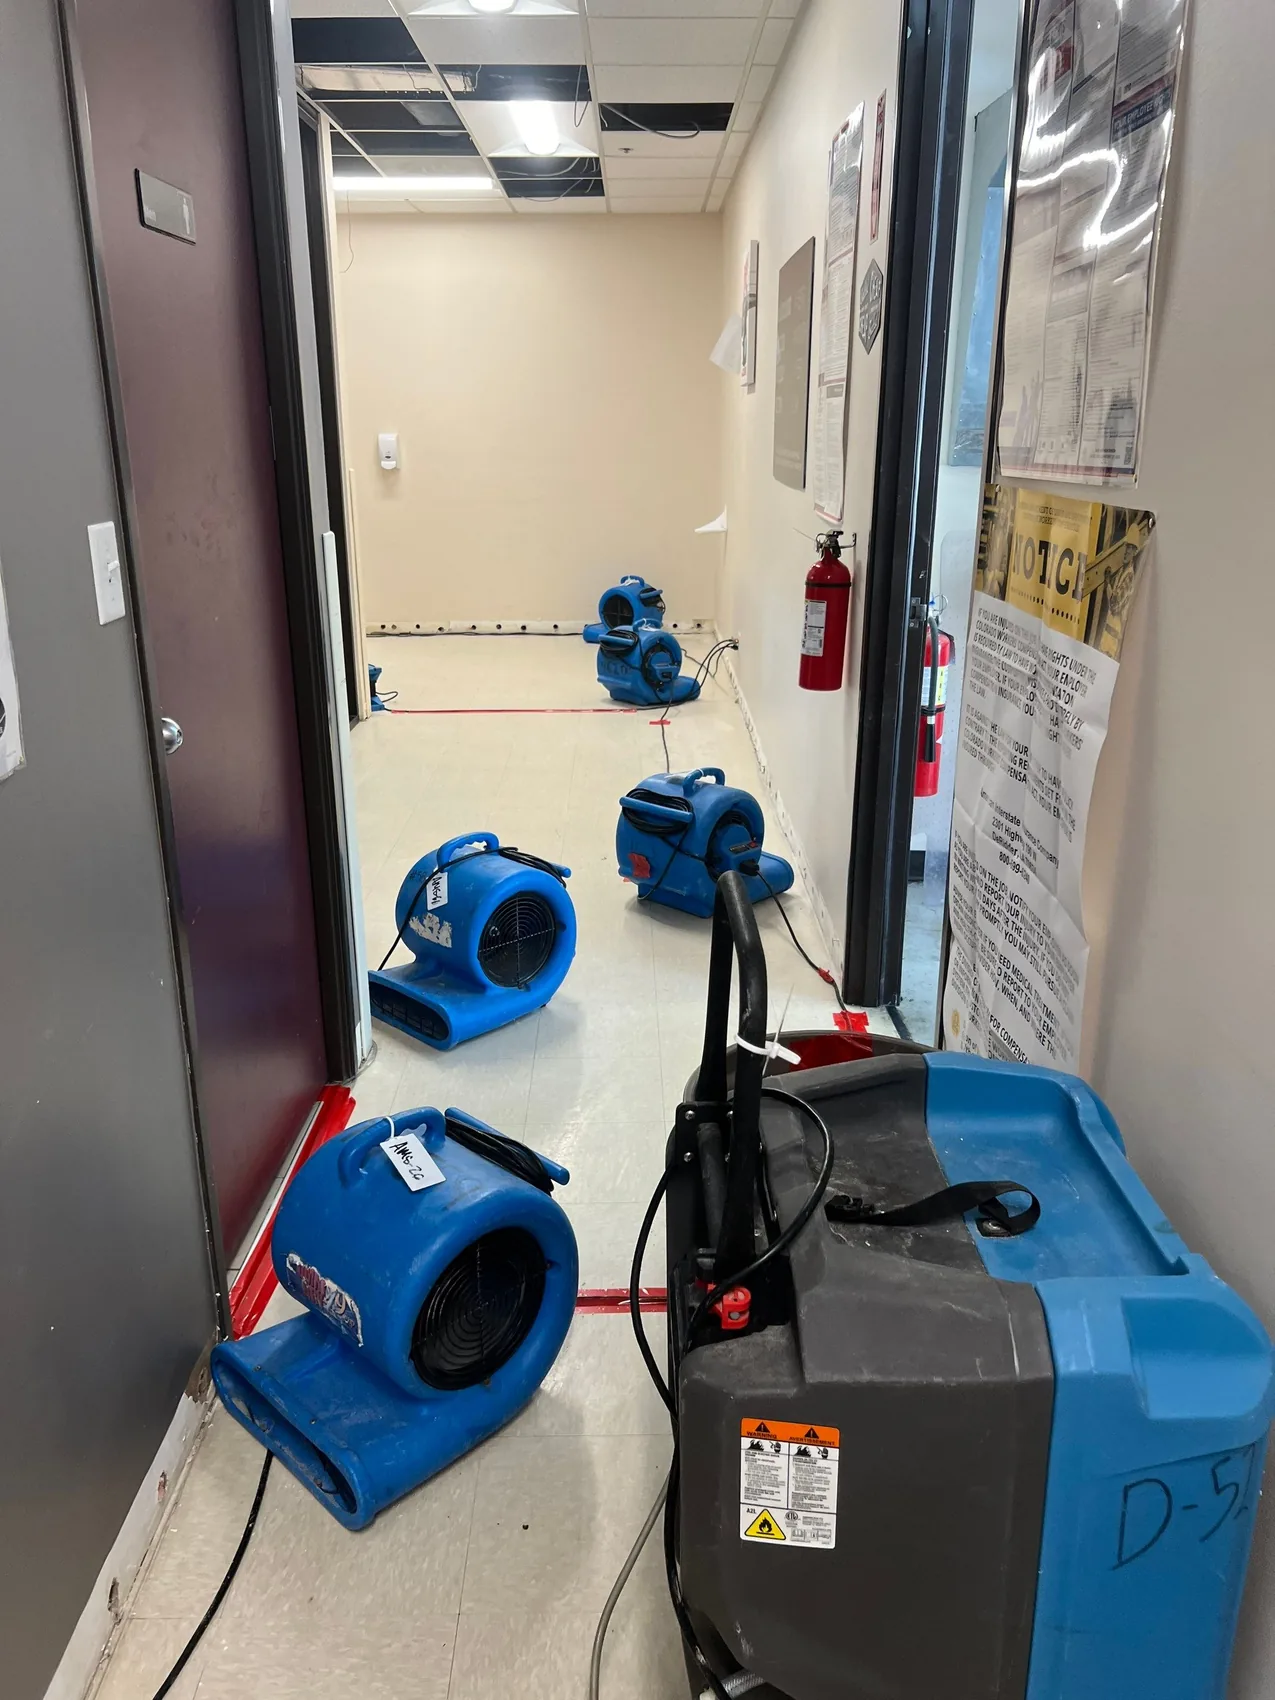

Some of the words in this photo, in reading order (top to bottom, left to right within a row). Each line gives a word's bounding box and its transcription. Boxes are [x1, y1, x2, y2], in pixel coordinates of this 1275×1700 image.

[987, 871, 999, 888] THE
[982, 893, 996, 913] DAYS
[1011, 920, 1023, 938] THE
[1004, 928, 1019, 948] YOU
[1018, 941, 1031, 960] MAY
[1002, 971, 1024, 999] REPORT
[1023, 992, 1032, 1008] TO
[1011, 963, 1034, 996] MEDICAL
[1001, 982, 1019, 1011] WHEN,
[1018, 1004, 1031, 1023] AND
[989, 1013, 1001, 1033] FOR
[999, 1027, 1029, 1064] COMPENSA
[746, 1431, 777, 1440] WARNING
[789, 1437, 835, 1447] AVERTISSEMENT
